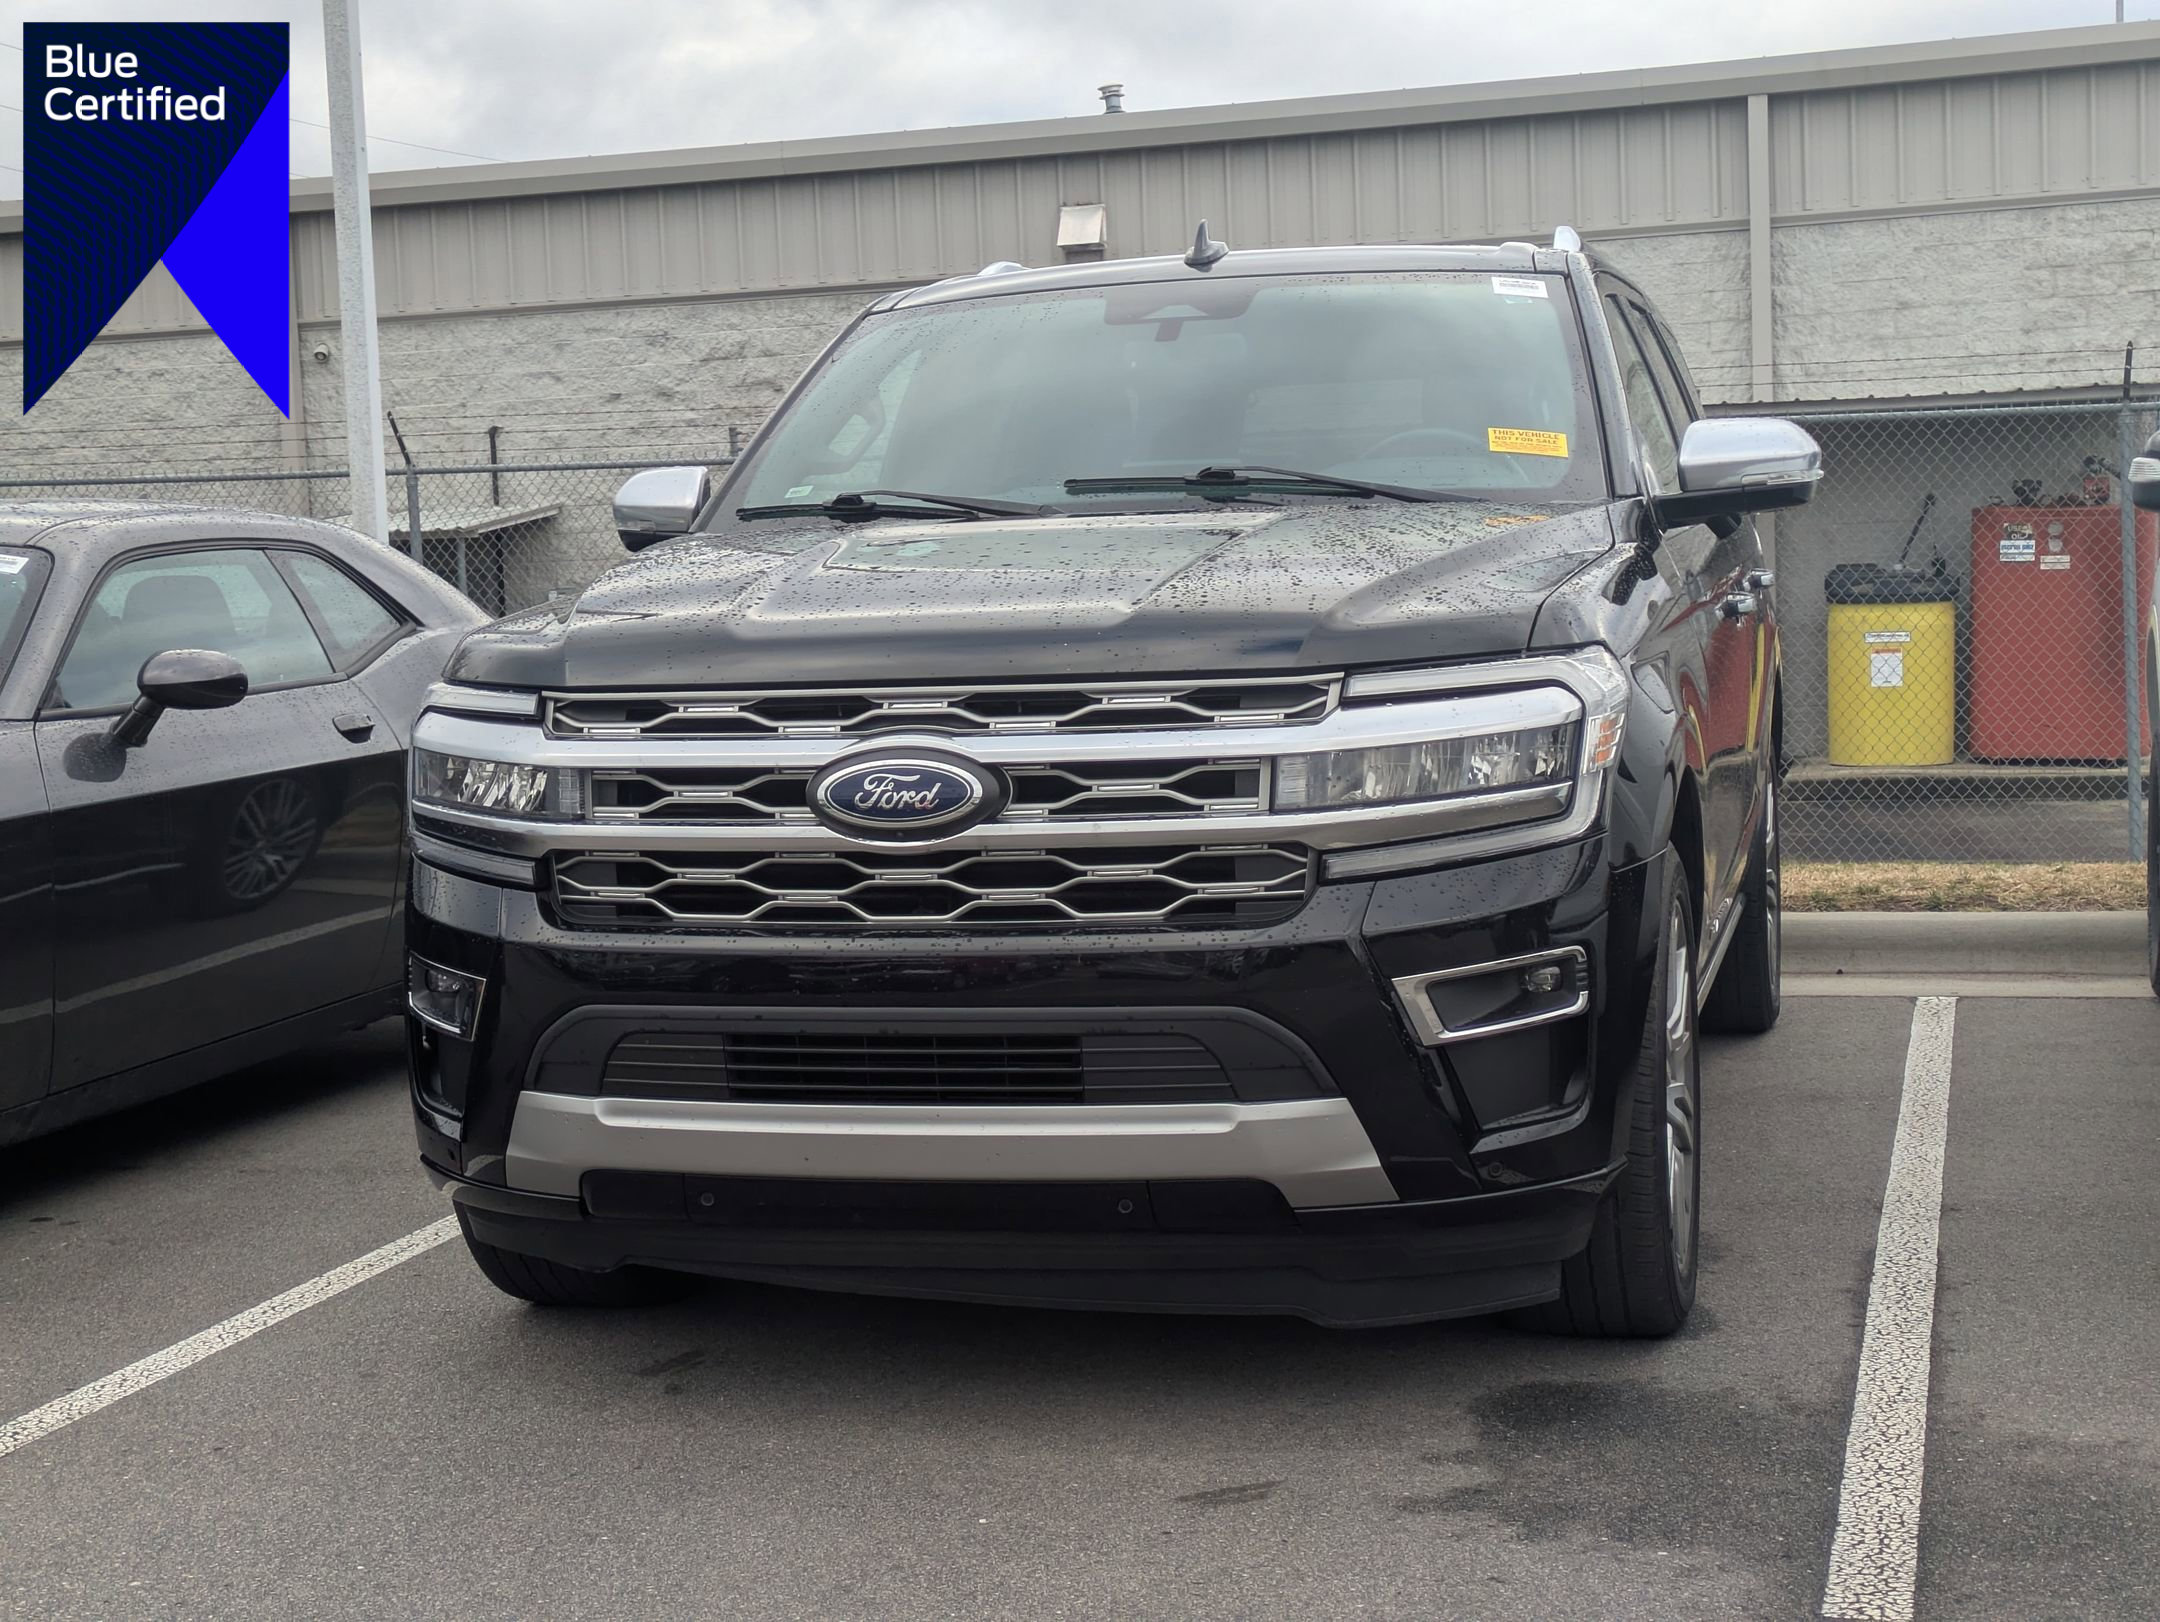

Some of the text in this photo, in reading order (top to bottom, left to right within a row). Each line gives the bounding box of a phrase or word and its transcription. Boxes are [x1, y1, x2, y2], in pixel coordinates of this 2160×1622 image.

[1493, 429, 1560, 440] THIS VEHICLE
[854, 773, 942, 810] Ford
